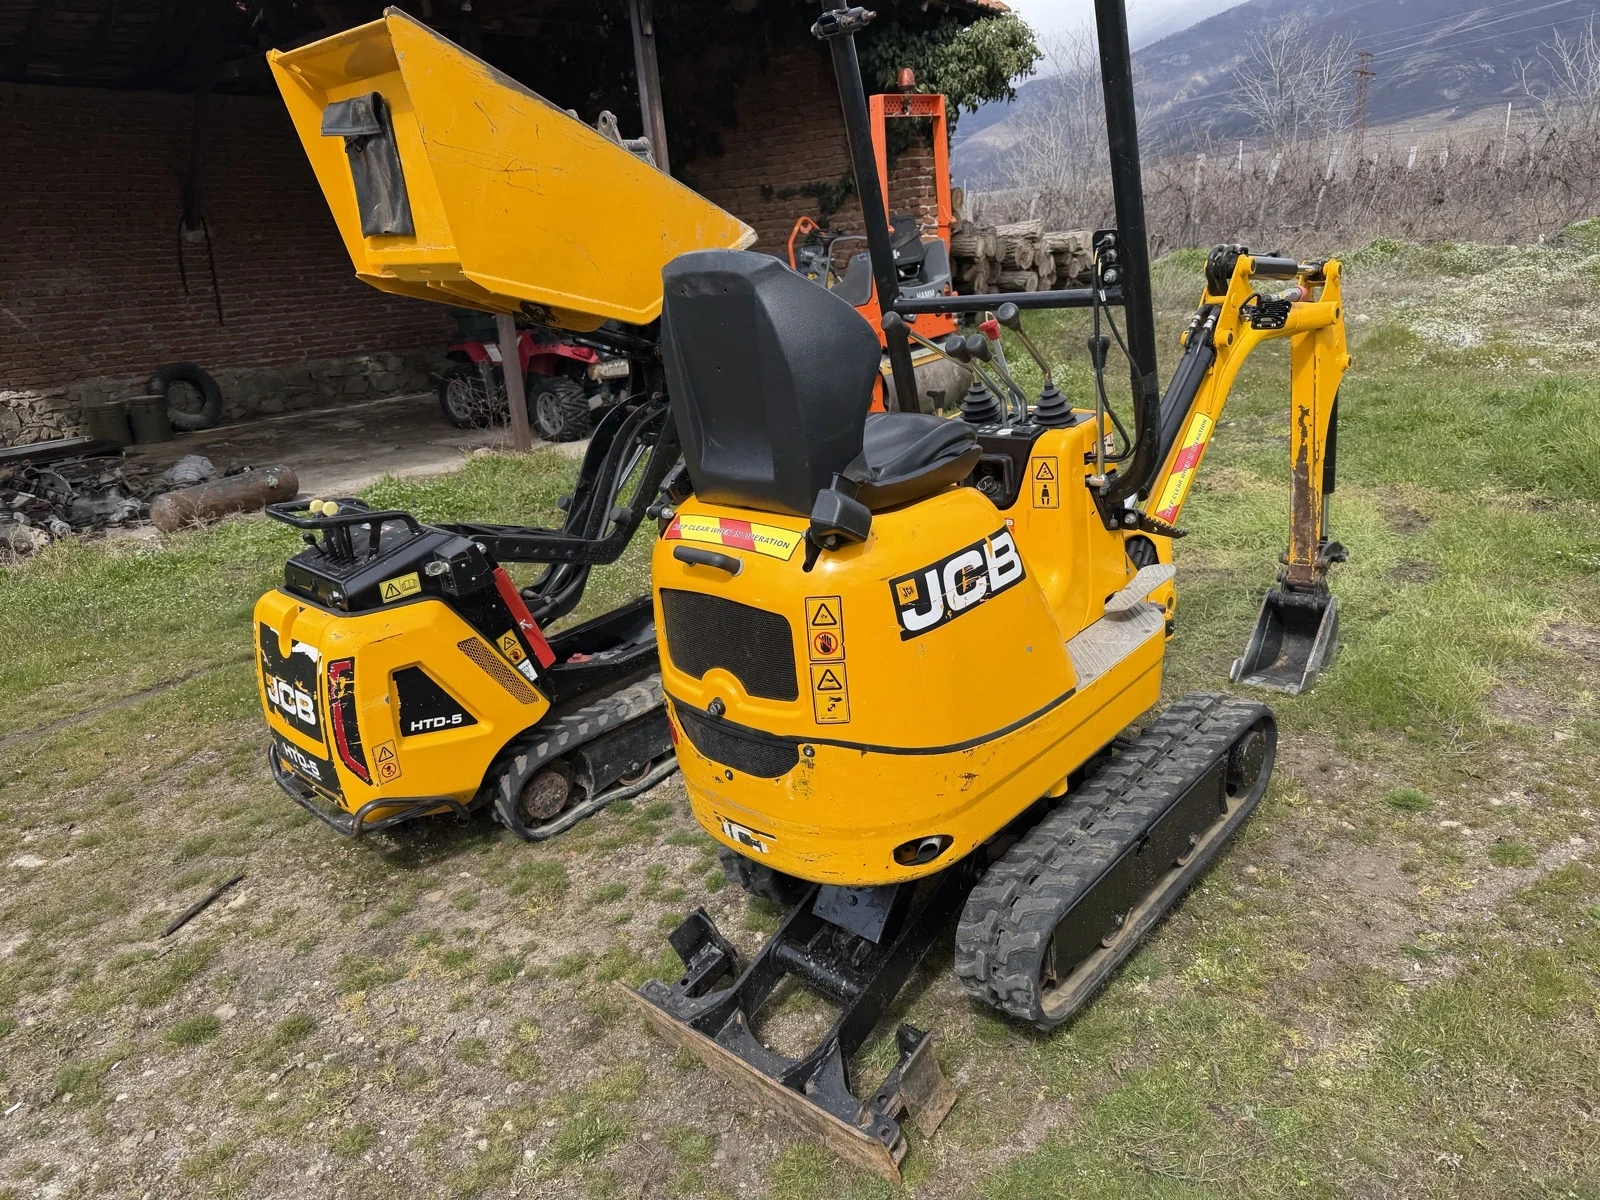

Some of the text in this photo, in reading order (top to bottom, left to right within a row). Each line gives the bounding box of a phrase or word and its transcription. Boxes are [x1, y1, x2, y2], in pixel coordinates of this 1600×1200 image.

[916, 289, 935, 299] HAMM
[1172, 480, 1183, 500] CLEAR
[1191, 418, 1207, 453] OPERATION
[688, 524, 710, 532] CLEAR
[710, 527, 732, 536] WHEN
[733, 530, 742, 538] IN
[743, 533, 791, 549] OPERATION
[901, 531, 1023, 632] JCB
[266, 676, 317, 726] JCB
[410, 713, 463, 732] HTD-5
[282, 741, 320, 777] HTD-5
